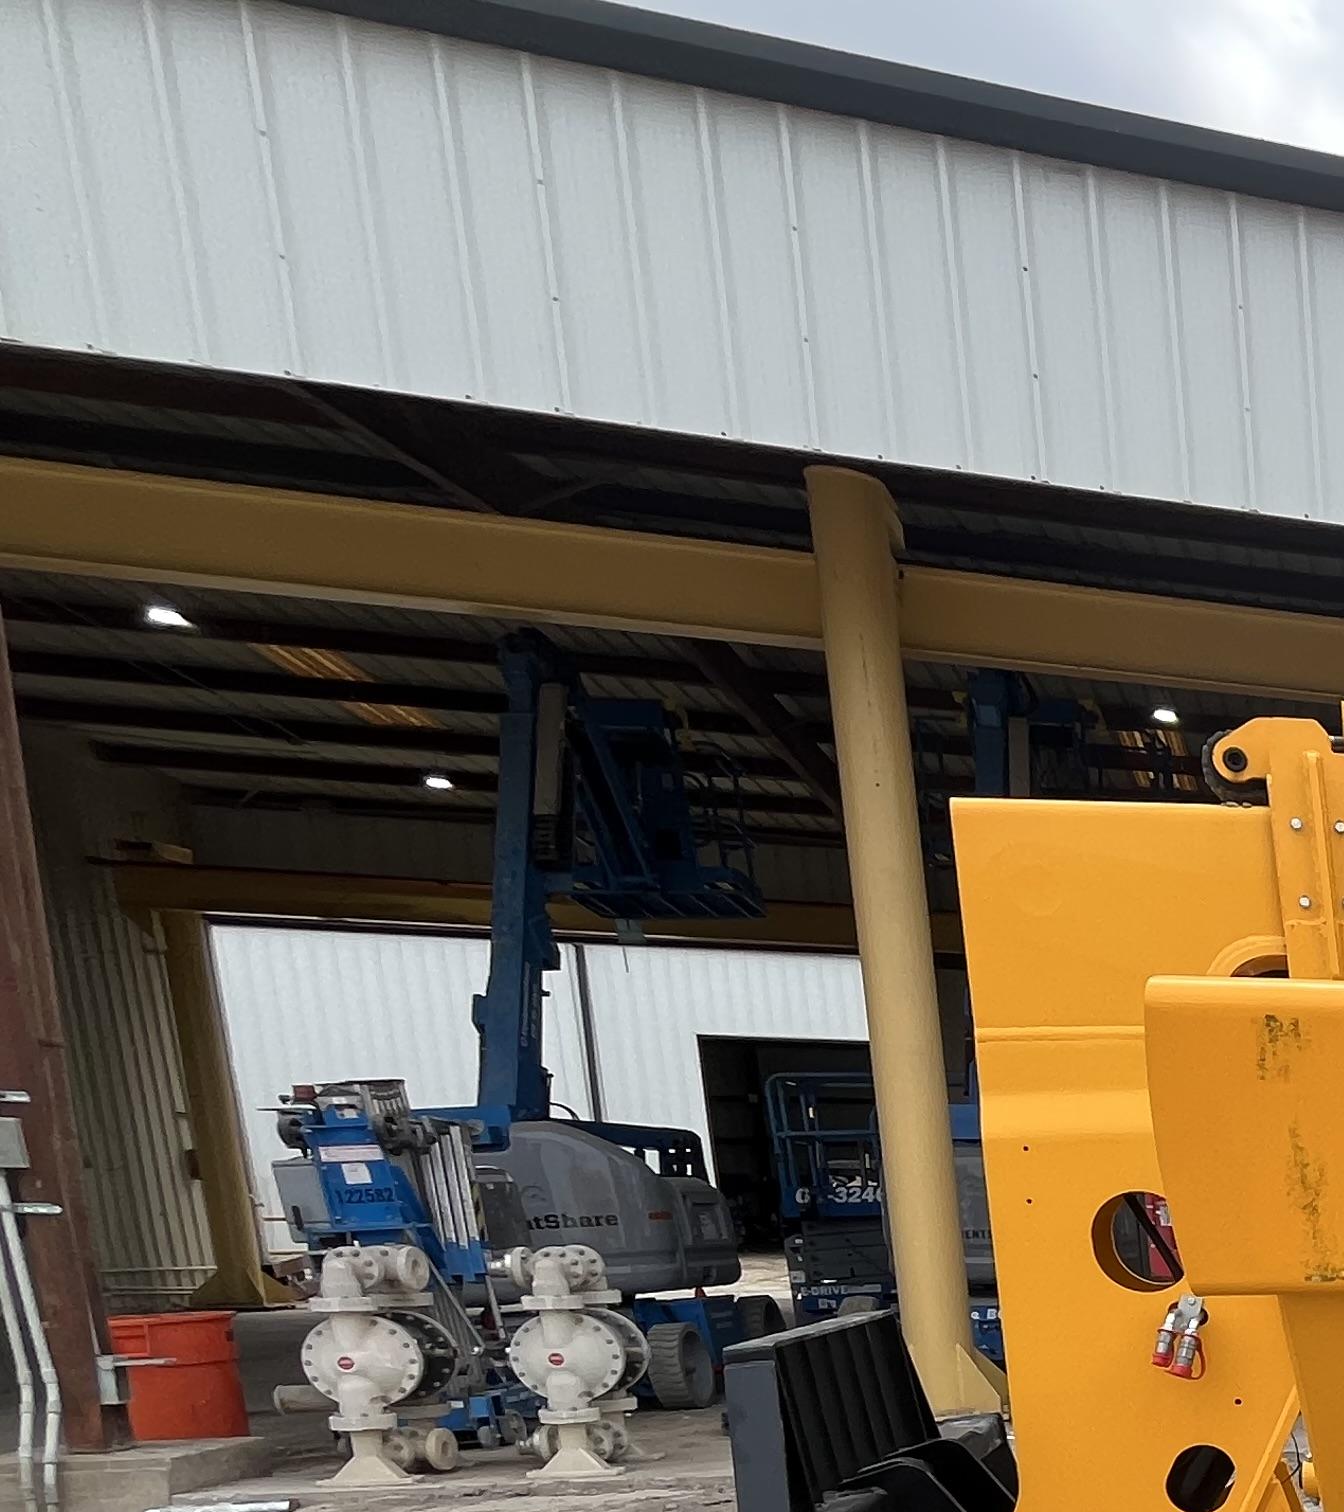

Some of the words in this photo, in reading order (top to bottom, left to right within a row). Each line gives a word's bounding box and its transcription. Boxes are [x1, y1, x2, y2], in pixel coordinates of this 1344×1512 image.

[335, 1187, 394, 1205] 122582
[795, 1186, 883, 1204] G-324
[801, 1285, 849, 1297] E-DRIVE
